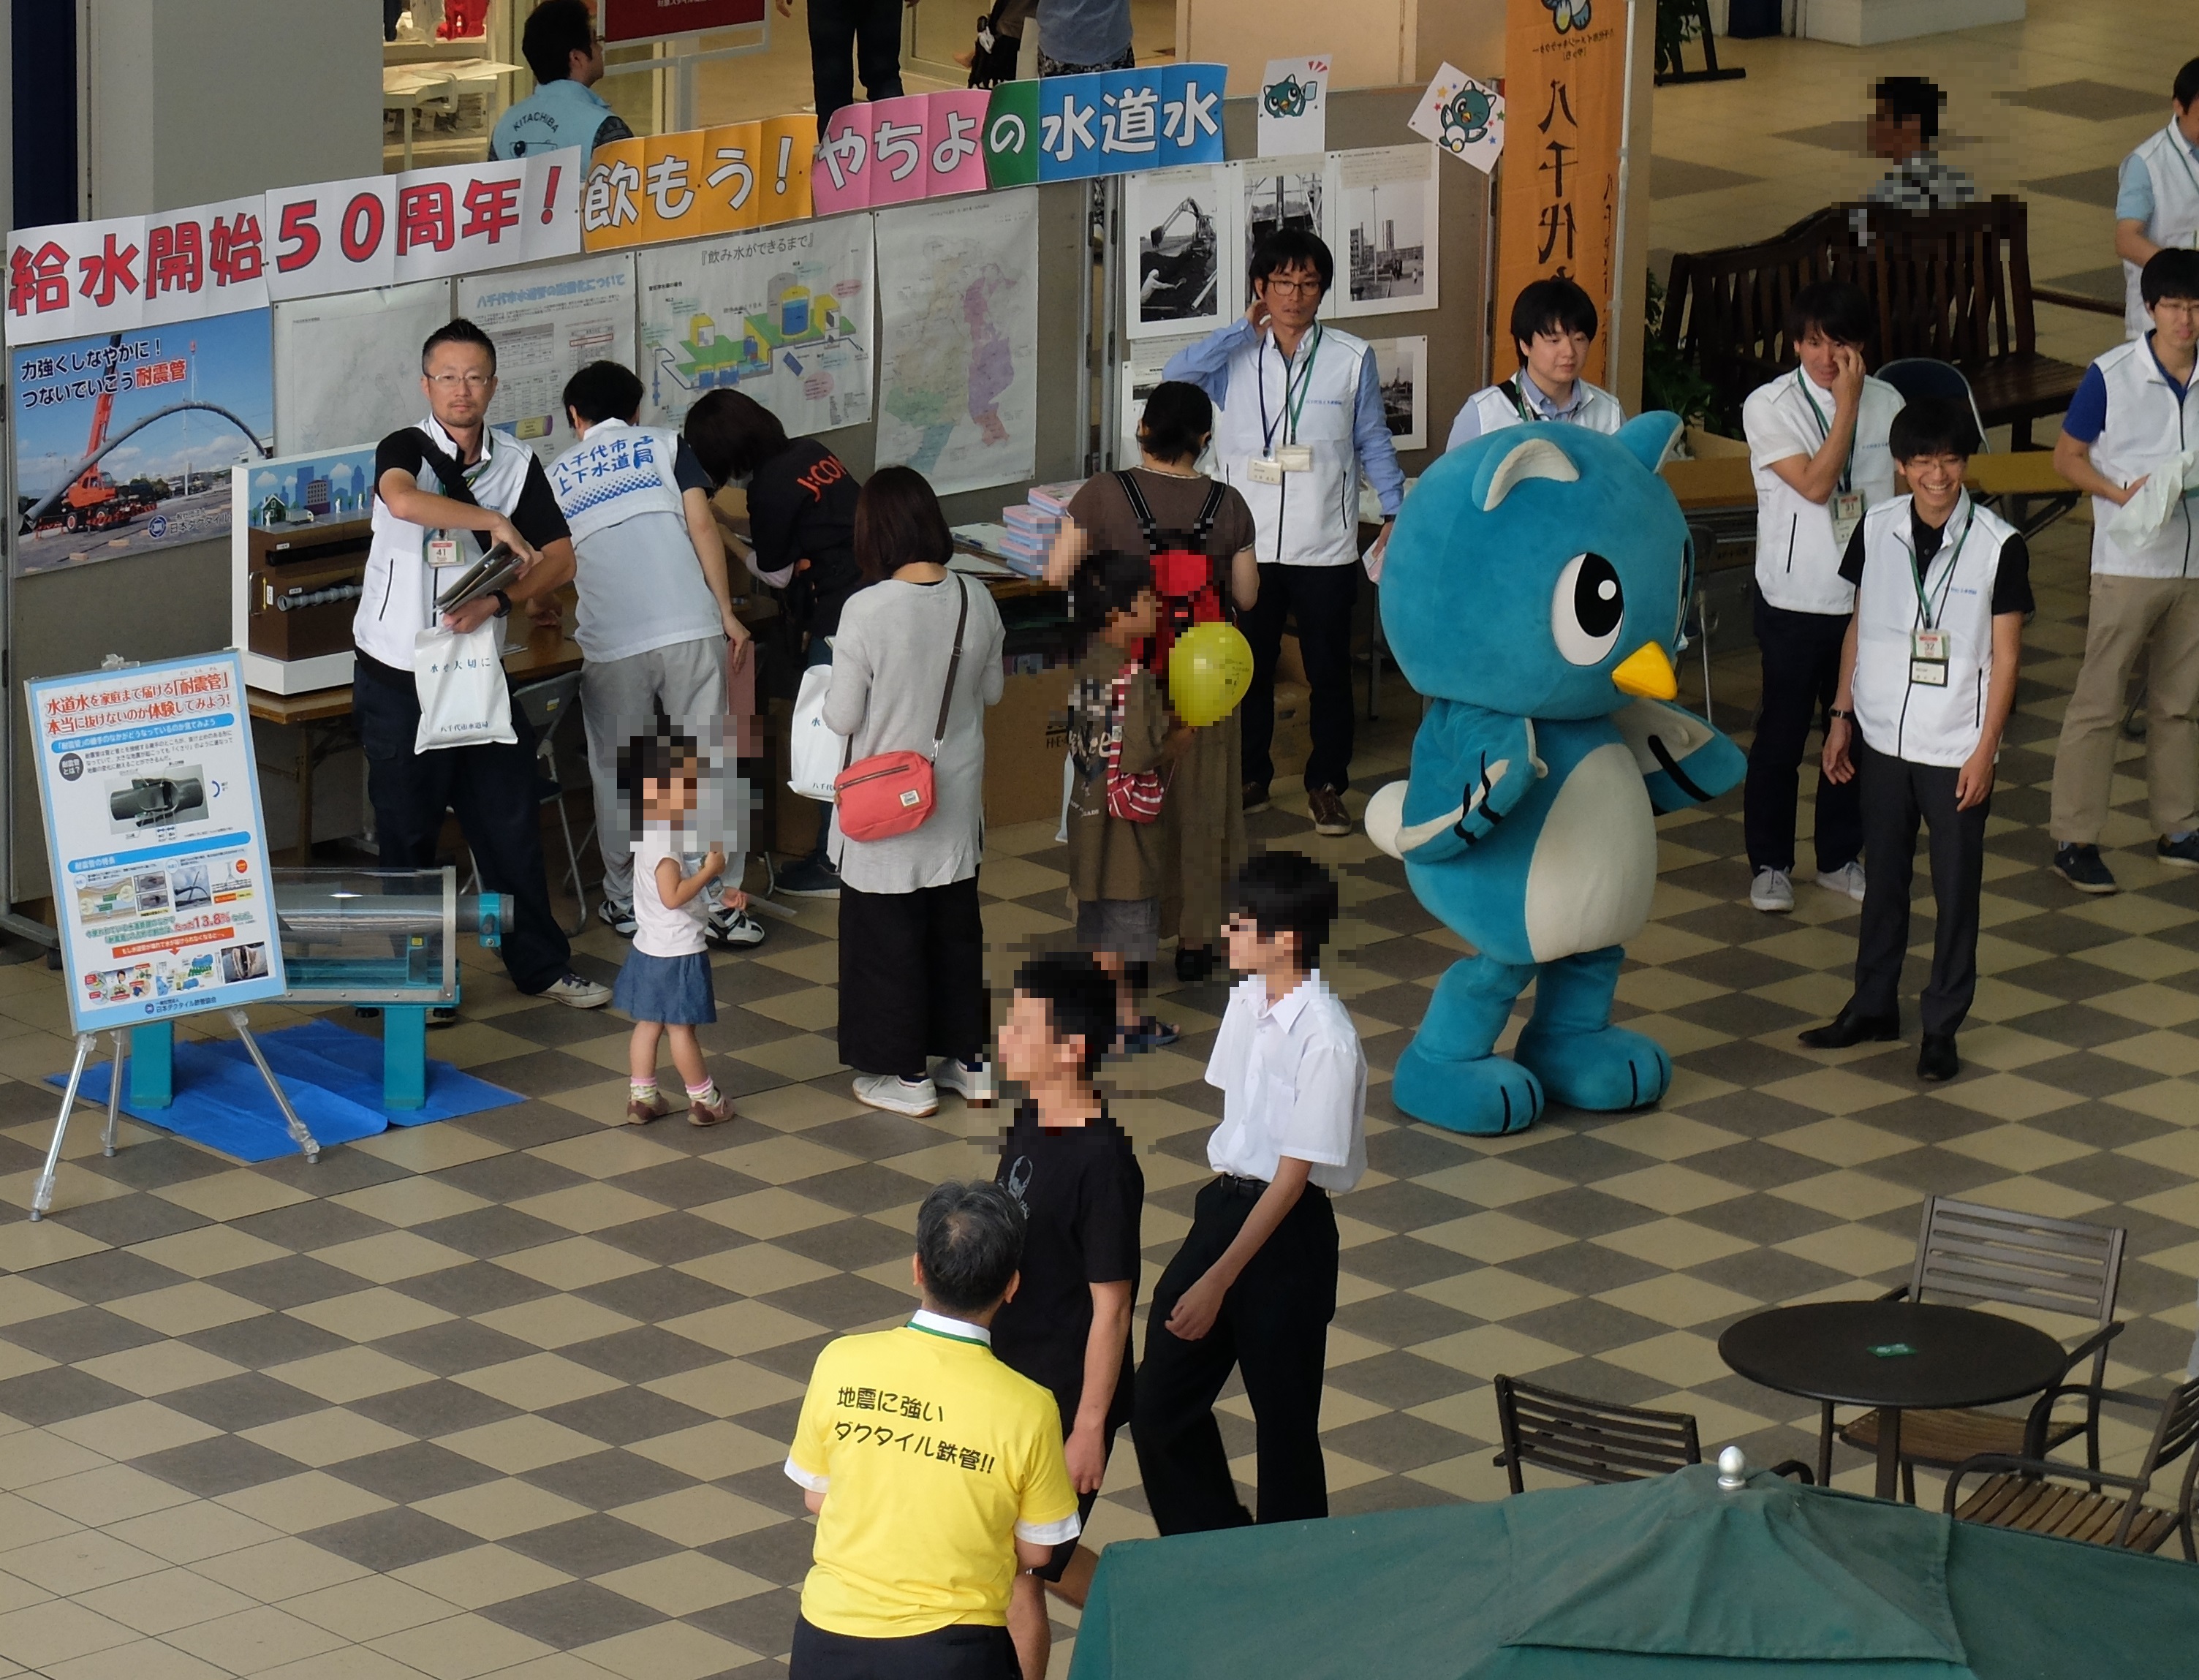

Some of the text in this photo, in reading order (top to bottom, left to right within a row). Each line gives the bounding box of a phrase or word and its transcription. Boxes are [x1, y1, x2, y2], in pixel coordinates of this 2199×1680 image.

[513, 112, 559, 133] KITACHIBA
[585, 137, 792, 232] 飲もう！
[21, 338, 162, 382] 力強くしなやかに！
[22, 359, 186, 409] つないでいこう耐震管
[553, 439, 628, 477] 八千代市
[436, 548, 447, 558] 41
[47, 672, 229, 716] 水道水を家庭まで届ける「耐震管」
[836, 1385, 944, 1422] 地震に強い
[834, 1420, 996, 1474] ダクタイル鉄管!!
